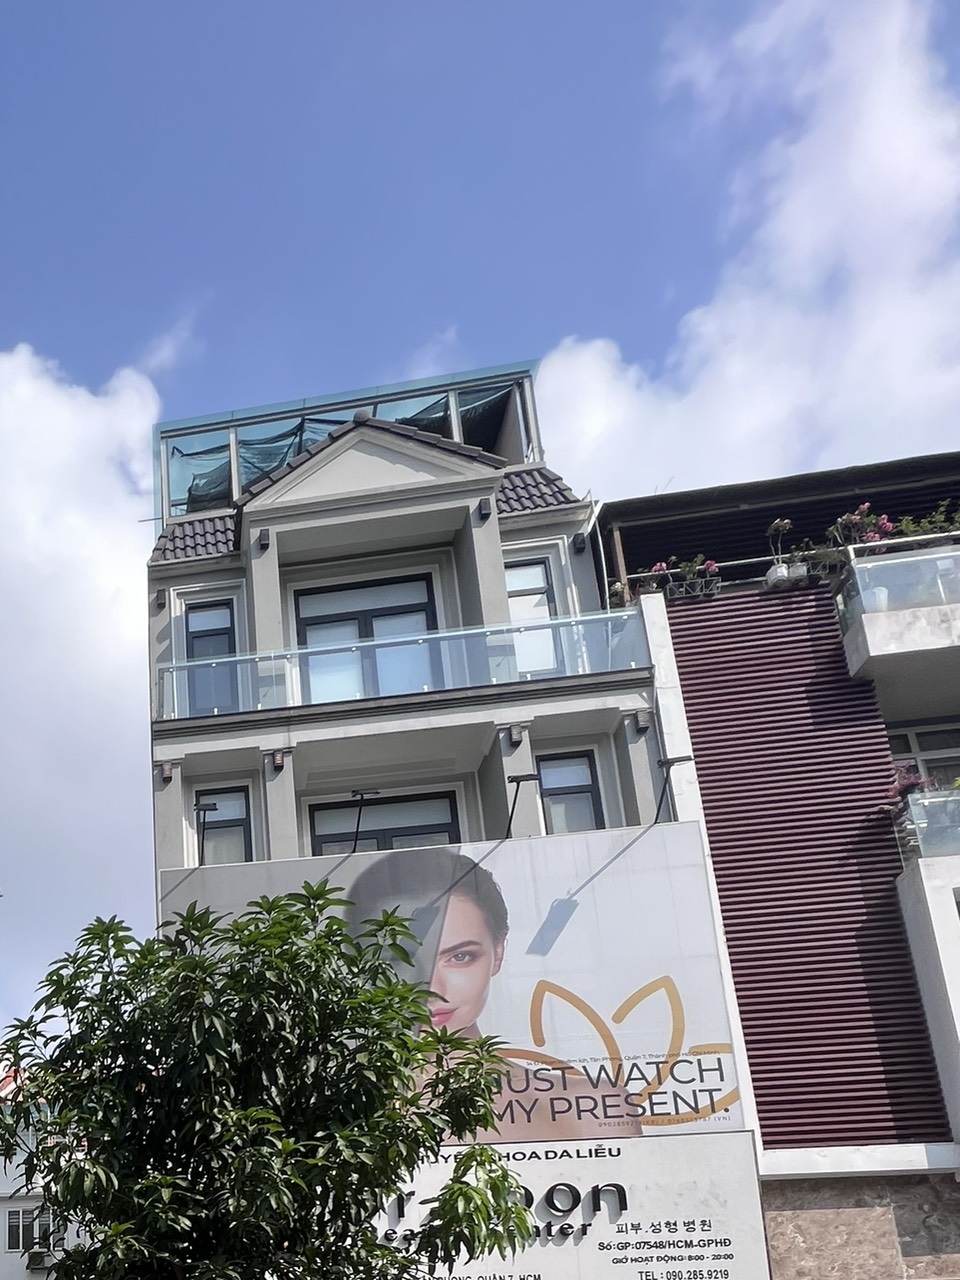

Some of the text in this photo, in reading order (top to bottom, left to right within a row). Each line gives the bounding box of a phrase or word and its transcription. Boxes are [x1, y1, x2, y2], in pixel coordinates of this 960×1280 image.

[582, 1057, 726, 1089] WATCH
[549, 1088, 730, 1122] PRESENT.
[666, 1269, 730, 1280] 090.285.9219
